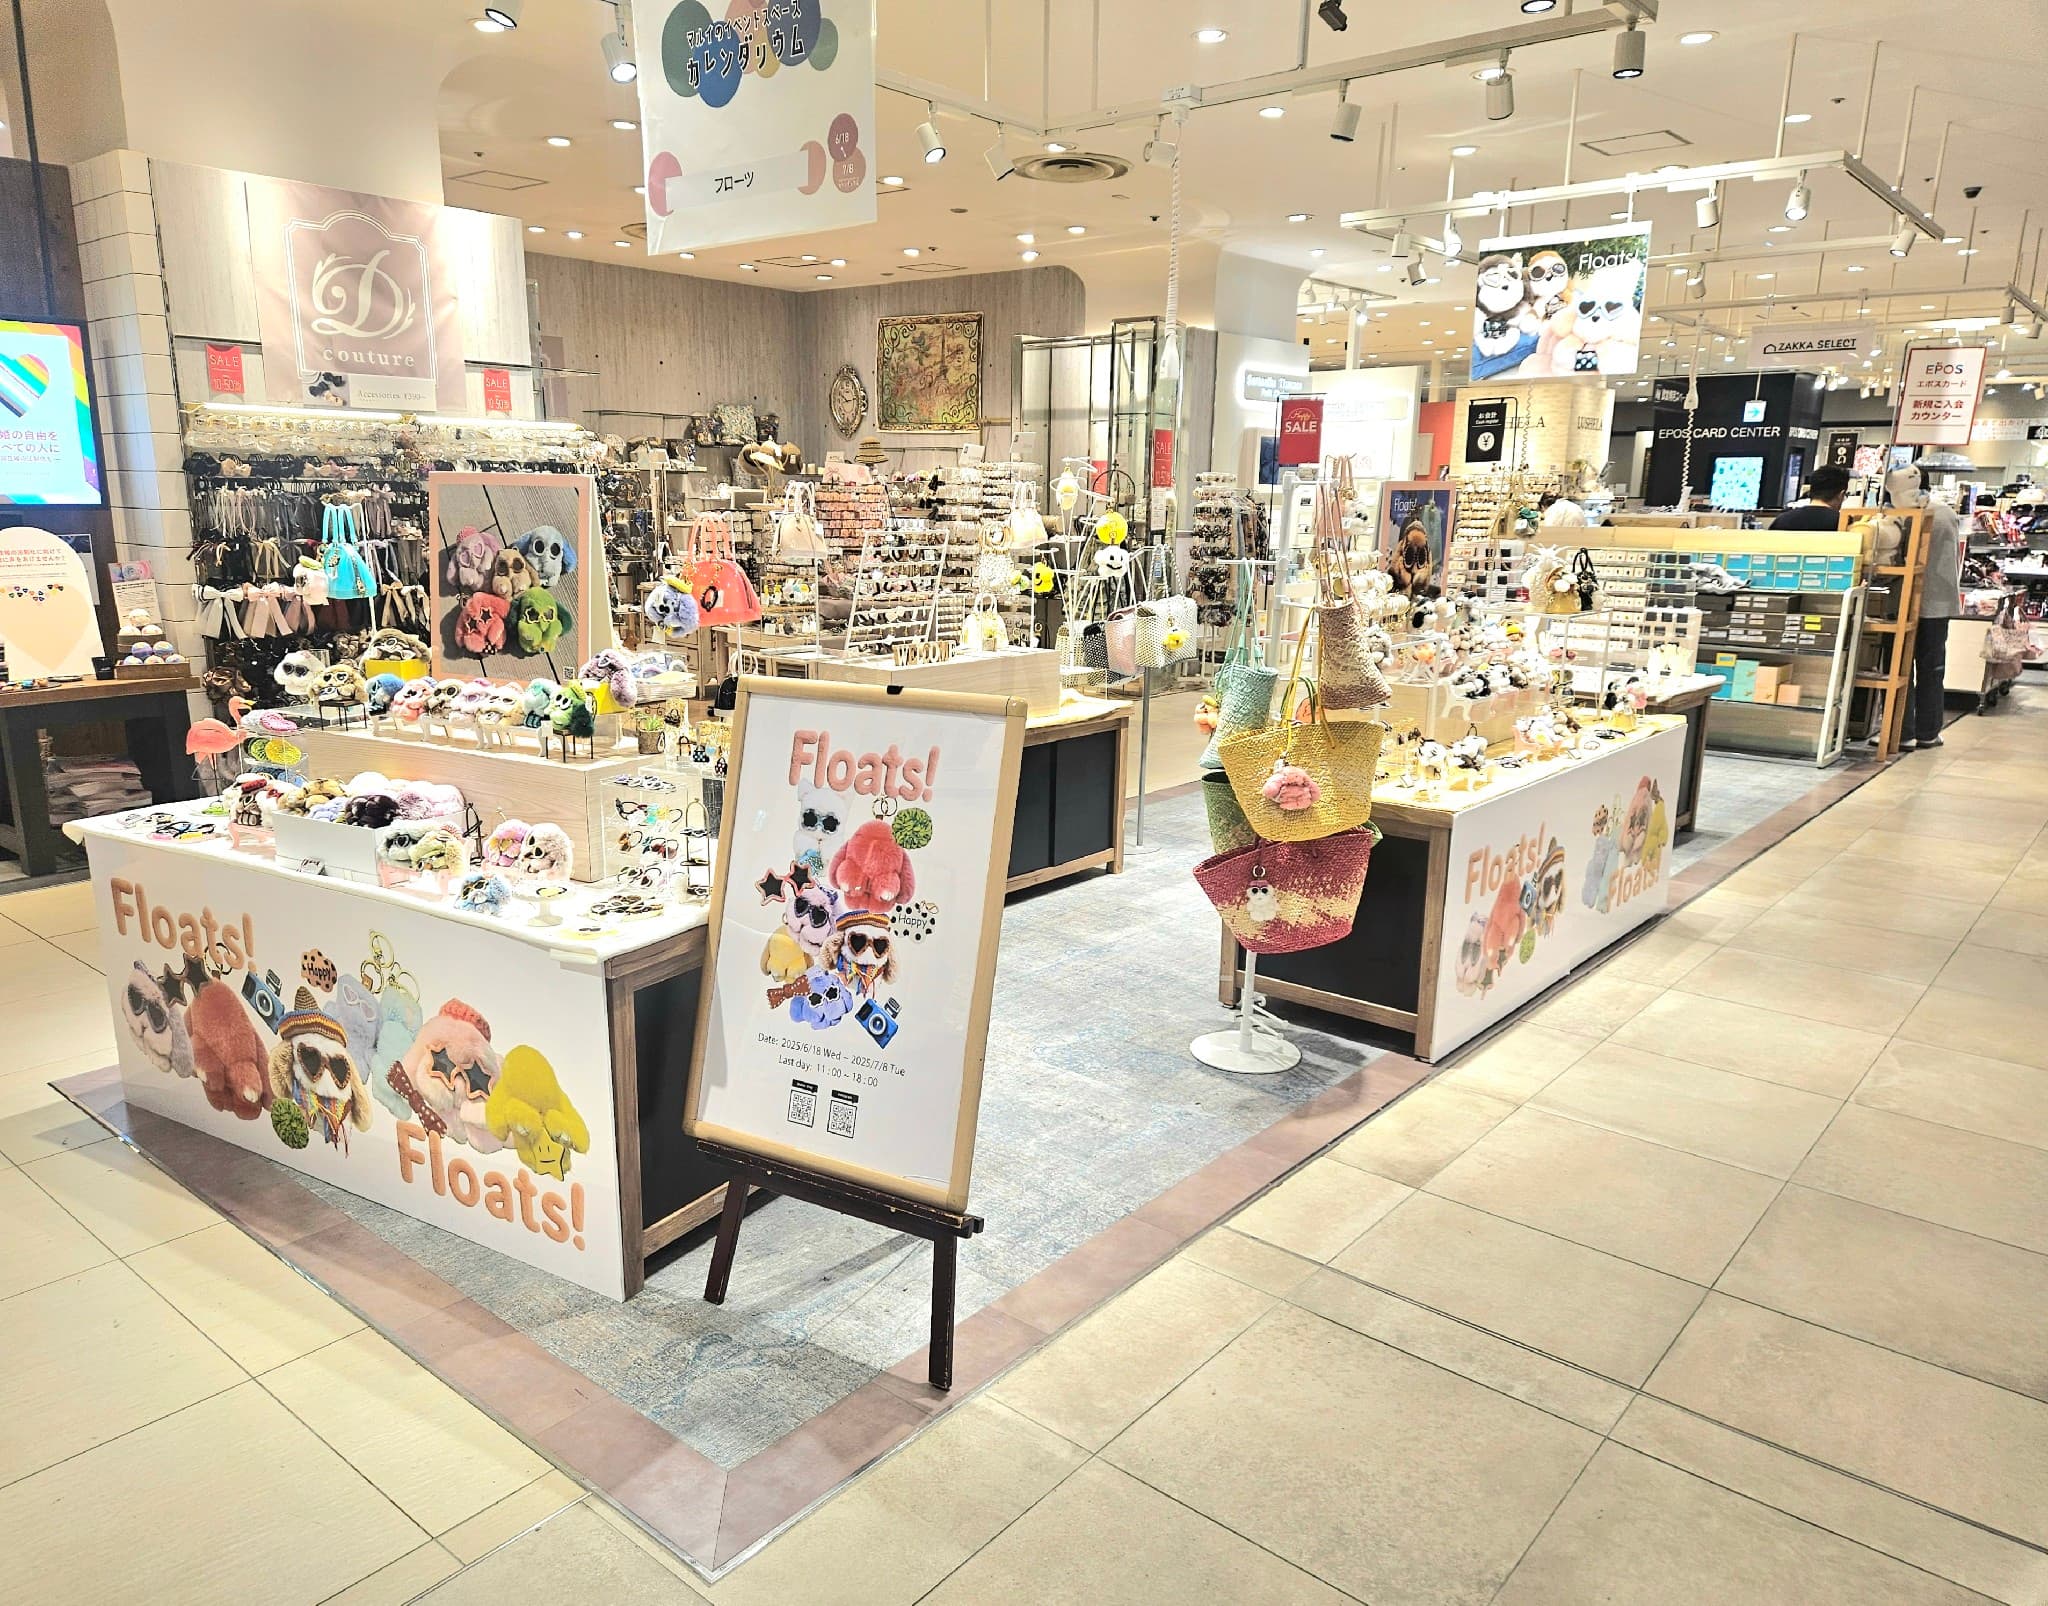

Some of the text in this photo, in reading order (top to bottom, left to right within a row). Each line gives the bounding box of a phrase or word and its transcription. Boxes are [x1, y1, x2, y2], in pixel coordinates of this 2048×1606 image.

[686, 0, 802, 48] マルイのイベントスペース
[686, 24, 805, 88] カレンダリウム
[835, 132, 849, 145] 6/18
[842, 163, 854, 175] 7/8
[714, 171, 754, 193] フローツ
[1778, 338, 1857, 351] ZAKKA SELECT
[209, 354, 239, 367] SALE
[323, 349, 416, 368] couture
[1925, 363, 1964, 375] EPOS
[486, 377, 508, 388] SALE
[1912, 400, 1964, 409] 新規ご入会
[1911, 411, 1962, 421] カウンター
[1285, 421, 1318, 433] SALE
[1659, 428, 1690, 439] EPOS
[1692, 427, 1728, 439] CARD
[1730, 426, 1781, 438] CENTER
[1156, 441, 1172, 455] SALE
[892, 640, 957, 667] WELCOME
[788, 730, 941, 803] Floats!
[1464, 821, 1546, 905] Floats!
[1607, 858, 1662, 913] Floats!
[110, 877, 258, 973] Floats!
[898, 913, 928, 929] Happy
[307, 962, 331, 981] Happy
[758, 1032, 779, 1046] Date:
[781, 1038, 822, 1056] 2025/6/18
[823, 1047, 842, 1061] Wed
[851, 1055, 888, 1072] 2025/7/8
[890, 1064, 906, 1077] Tue
[778, 1055, 795, 1067] Last
[795, 1059, 813, 1072] day:
[396, 1120, 586, 1252] Floats!
